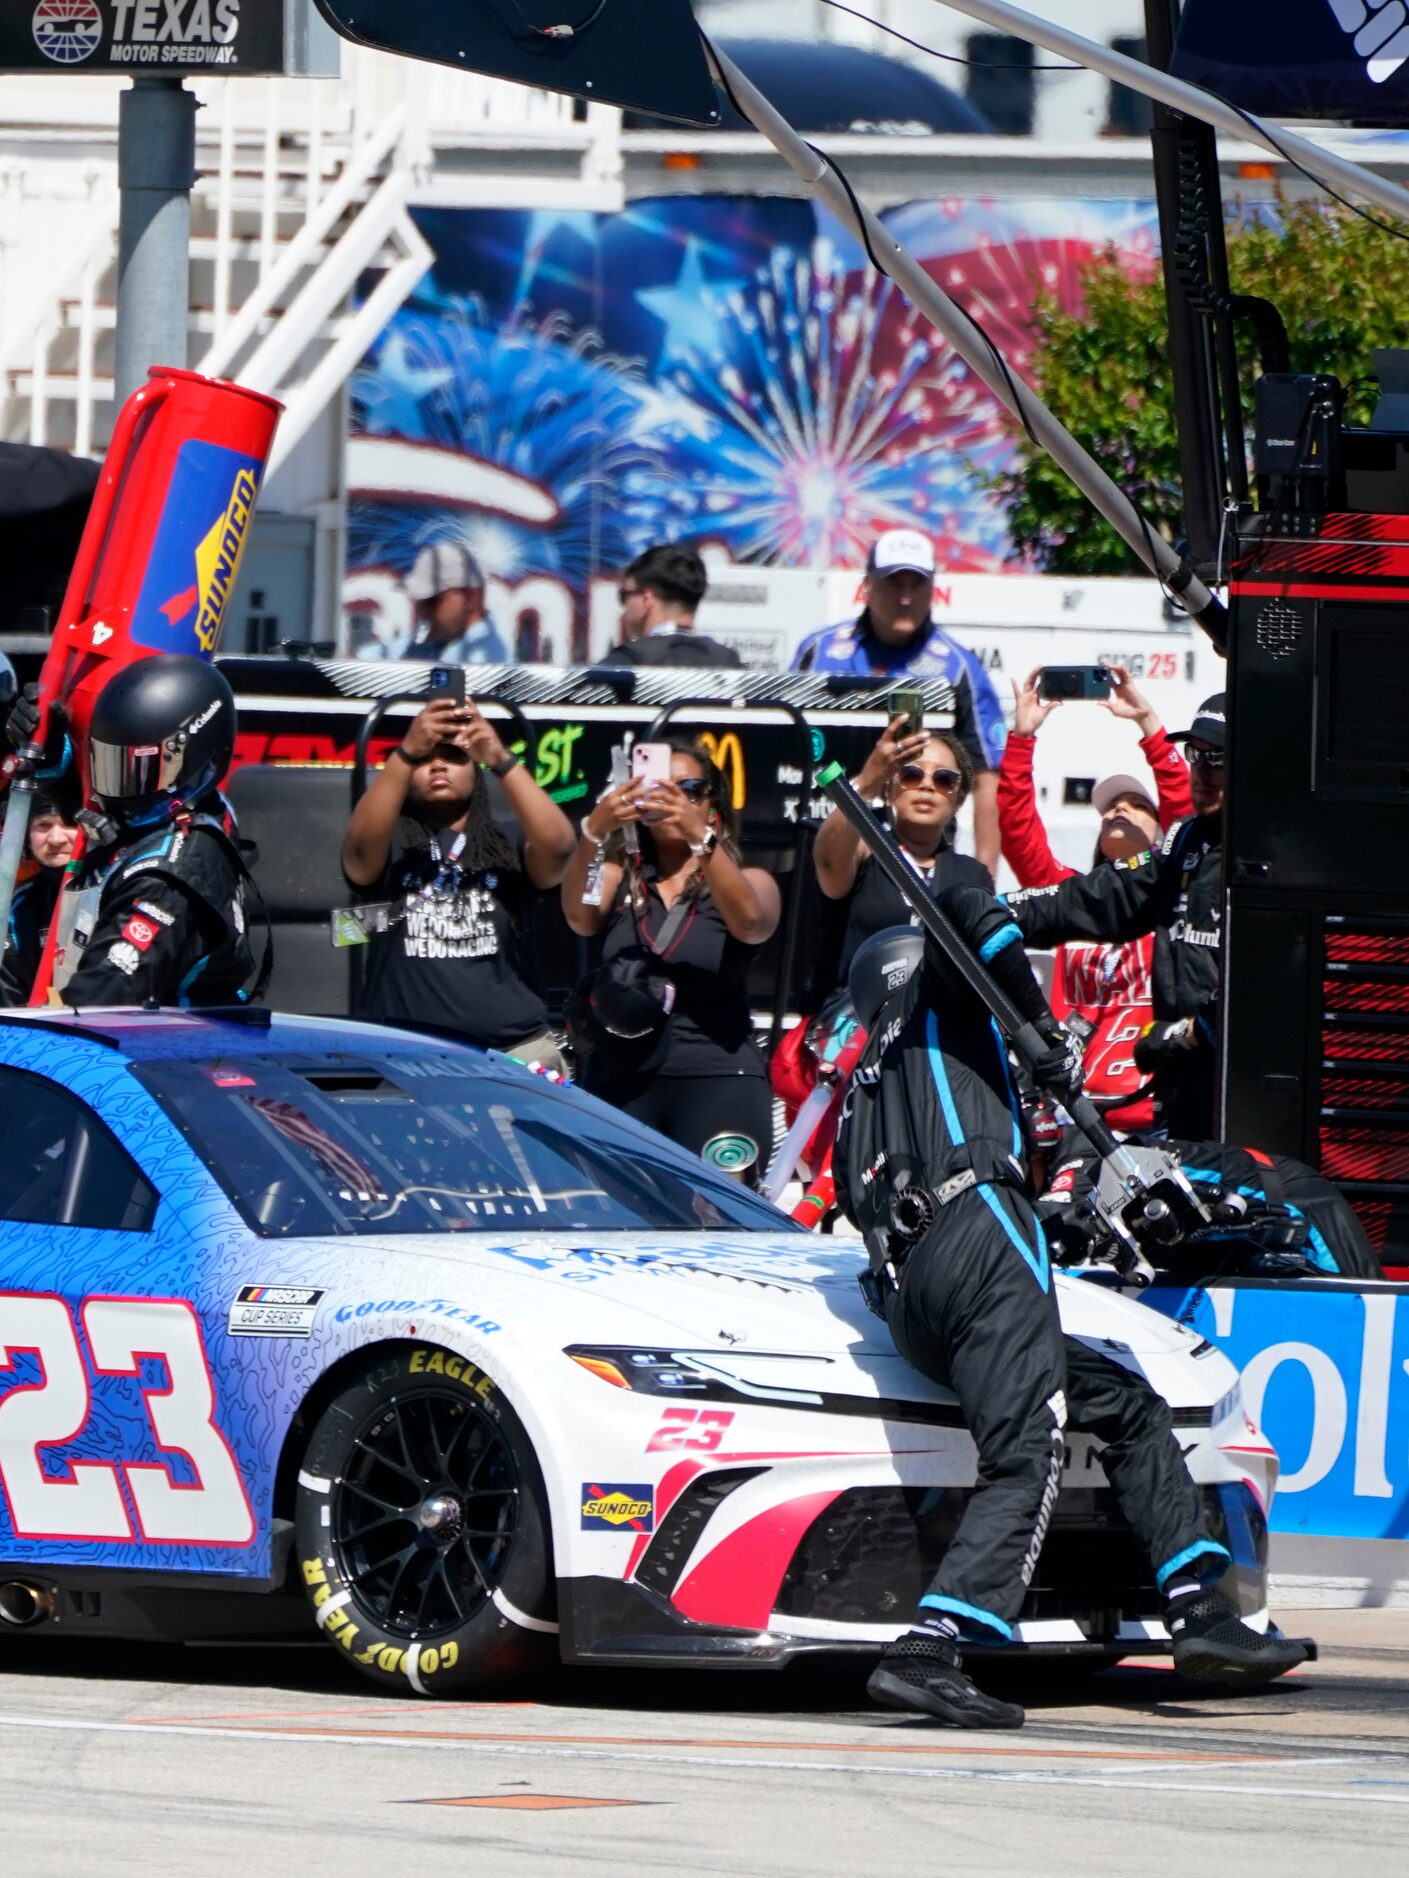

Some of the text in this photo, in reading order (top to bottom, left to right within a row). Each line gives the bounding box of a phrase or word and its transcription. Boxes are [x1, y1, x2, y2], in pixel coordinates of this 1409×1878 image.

[110, 0, 240, 43] TEXAS
[110, 45, 158, 62] MOTOR
[199, 478, 257, 649] SUNOCO
[1147, 654, 1177, 680] 25
[261, 1288, 316, 1304] NASCAR
[241, 1308, 304, 1325] CUP SERIES
[334, 1299, 502, 1335] GOODYEAR
[409, 1350, 497, 1400] EAGLE
[644, 1407, 736, 1454] 23
[586, 1502, 648, 1516] SUNOCO
[1021, 1427, 1065, 1587] Columbia
